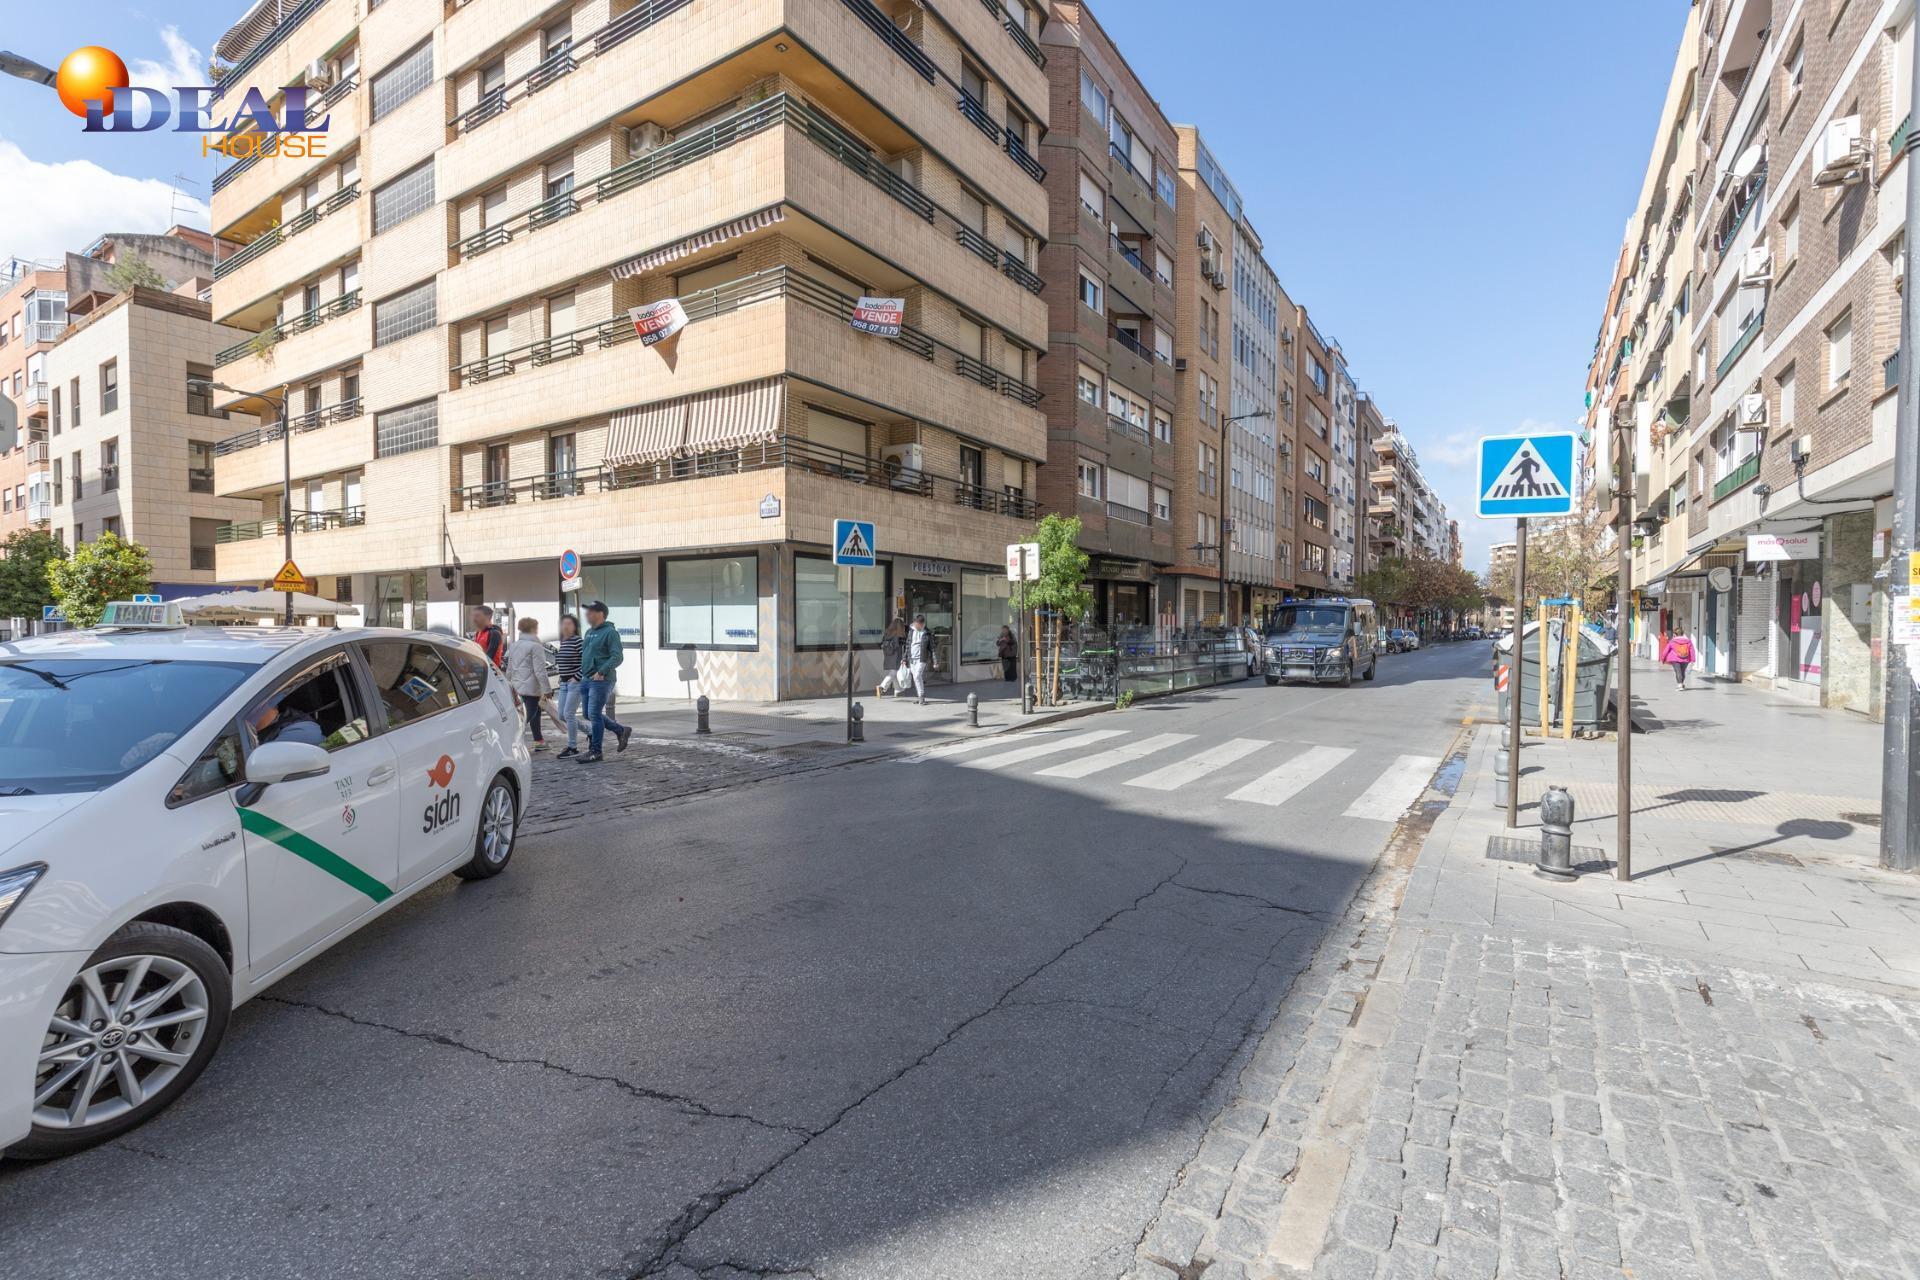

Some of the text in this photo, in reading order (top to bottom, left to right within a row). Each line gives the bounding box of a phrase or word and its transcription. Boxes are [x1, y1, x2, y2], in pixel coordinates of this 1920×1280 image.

[639, 312, 674, 333] VEND
[861, 310, 897, 324] VENDE
[852, 319, 898, 335] 958 07 11 79
[643, 333, 659, 345] 958
[1785, 536, 1808, 545] salud
[912, 561, 942, 573] PUESTO
[118, 605, 150, 622] TAXI
[334, 776, 353, 791] TAXI
[423, 789, 460, 834] sidn
